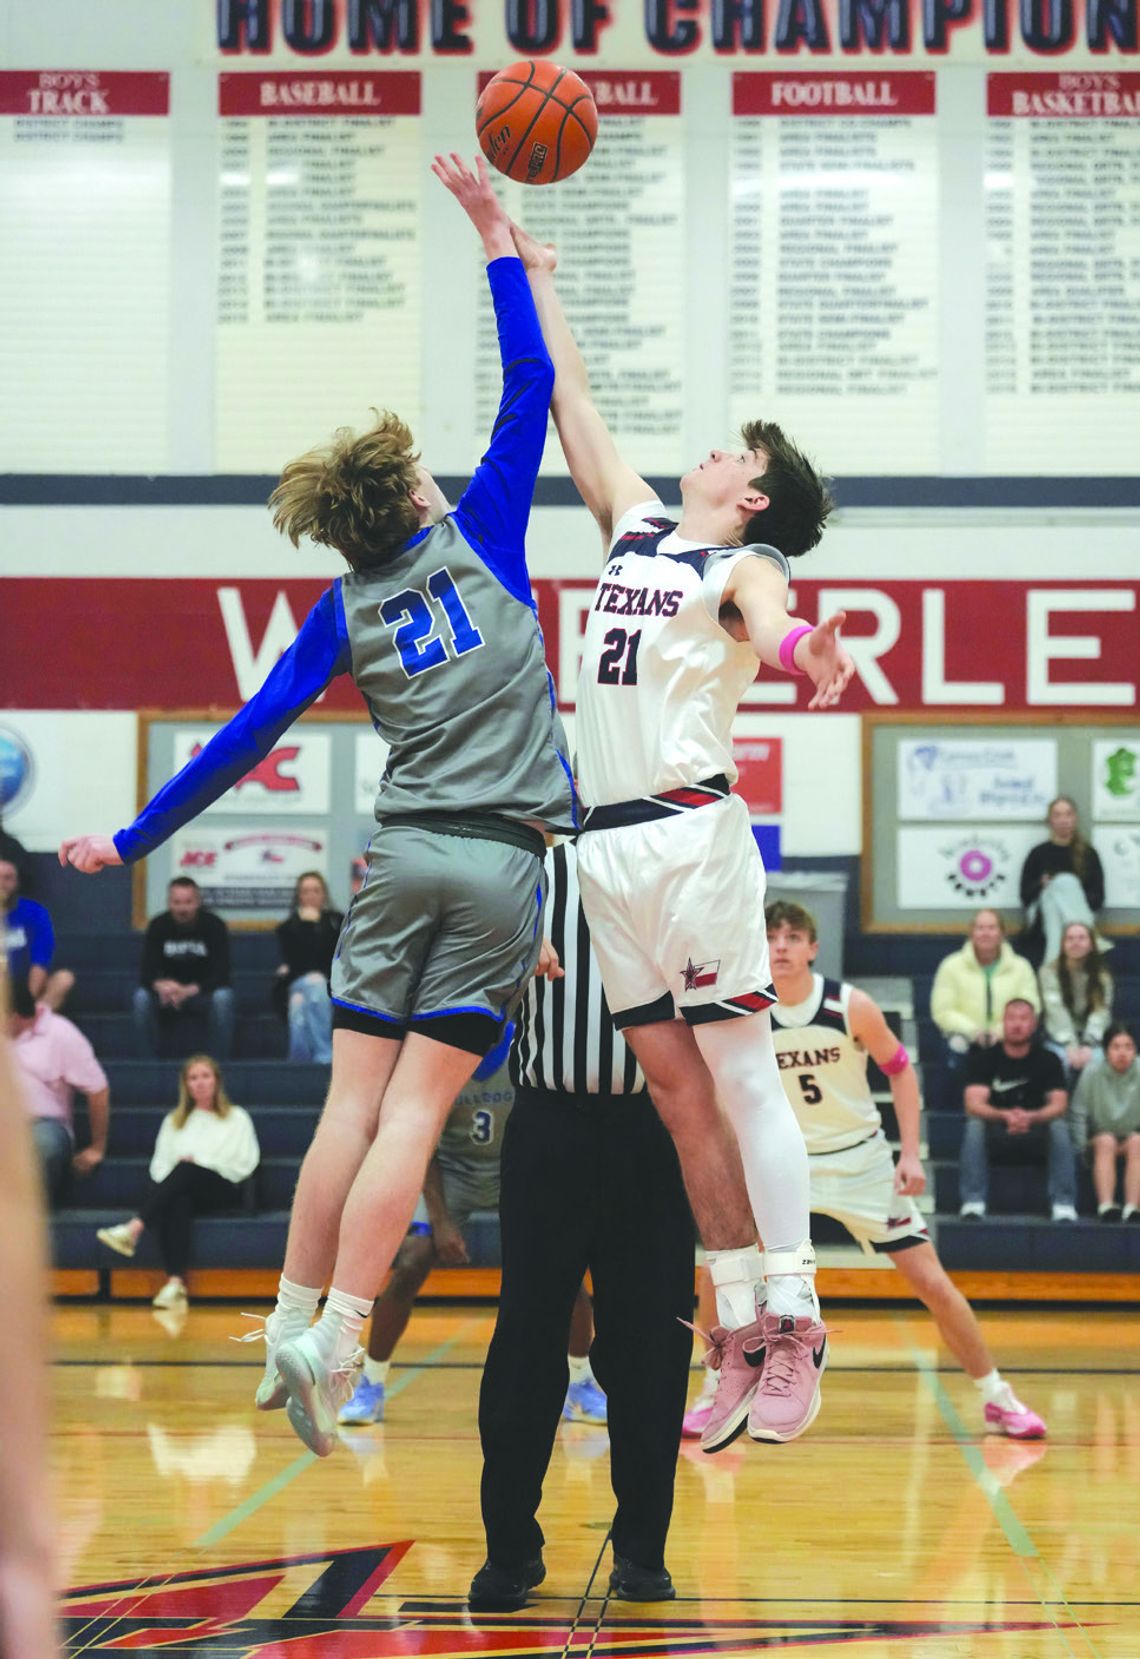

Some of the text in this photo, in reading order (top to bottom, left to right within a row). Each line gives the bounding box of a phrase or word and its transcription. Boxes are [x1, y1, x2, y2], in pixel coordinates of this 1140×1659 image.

[217, 0, 474, 55] HOME
[505, 0, 613, 56] OF
[40, 73, 99, 89] BOYS
[594, 80, 659, 106] BALL
[1058, 74, 1120, 90] BOYS
[28, 90, 110, 114] TRACK
[260, 82, 381, 106] BASEBALL
[771, 82, 899, 106] FOOTBALL
[1012, 91, 1140, 116] BASKETBA
[594, 583, 684, 617] TEXANS
[378, 566, 486, 679] 21
[597, 627, 642, 686] 21
[775, 1047, 841, 1070] EXANS
[798, 1074, 823, 1105] 5
[471, 1109, 494, 1145] 3
